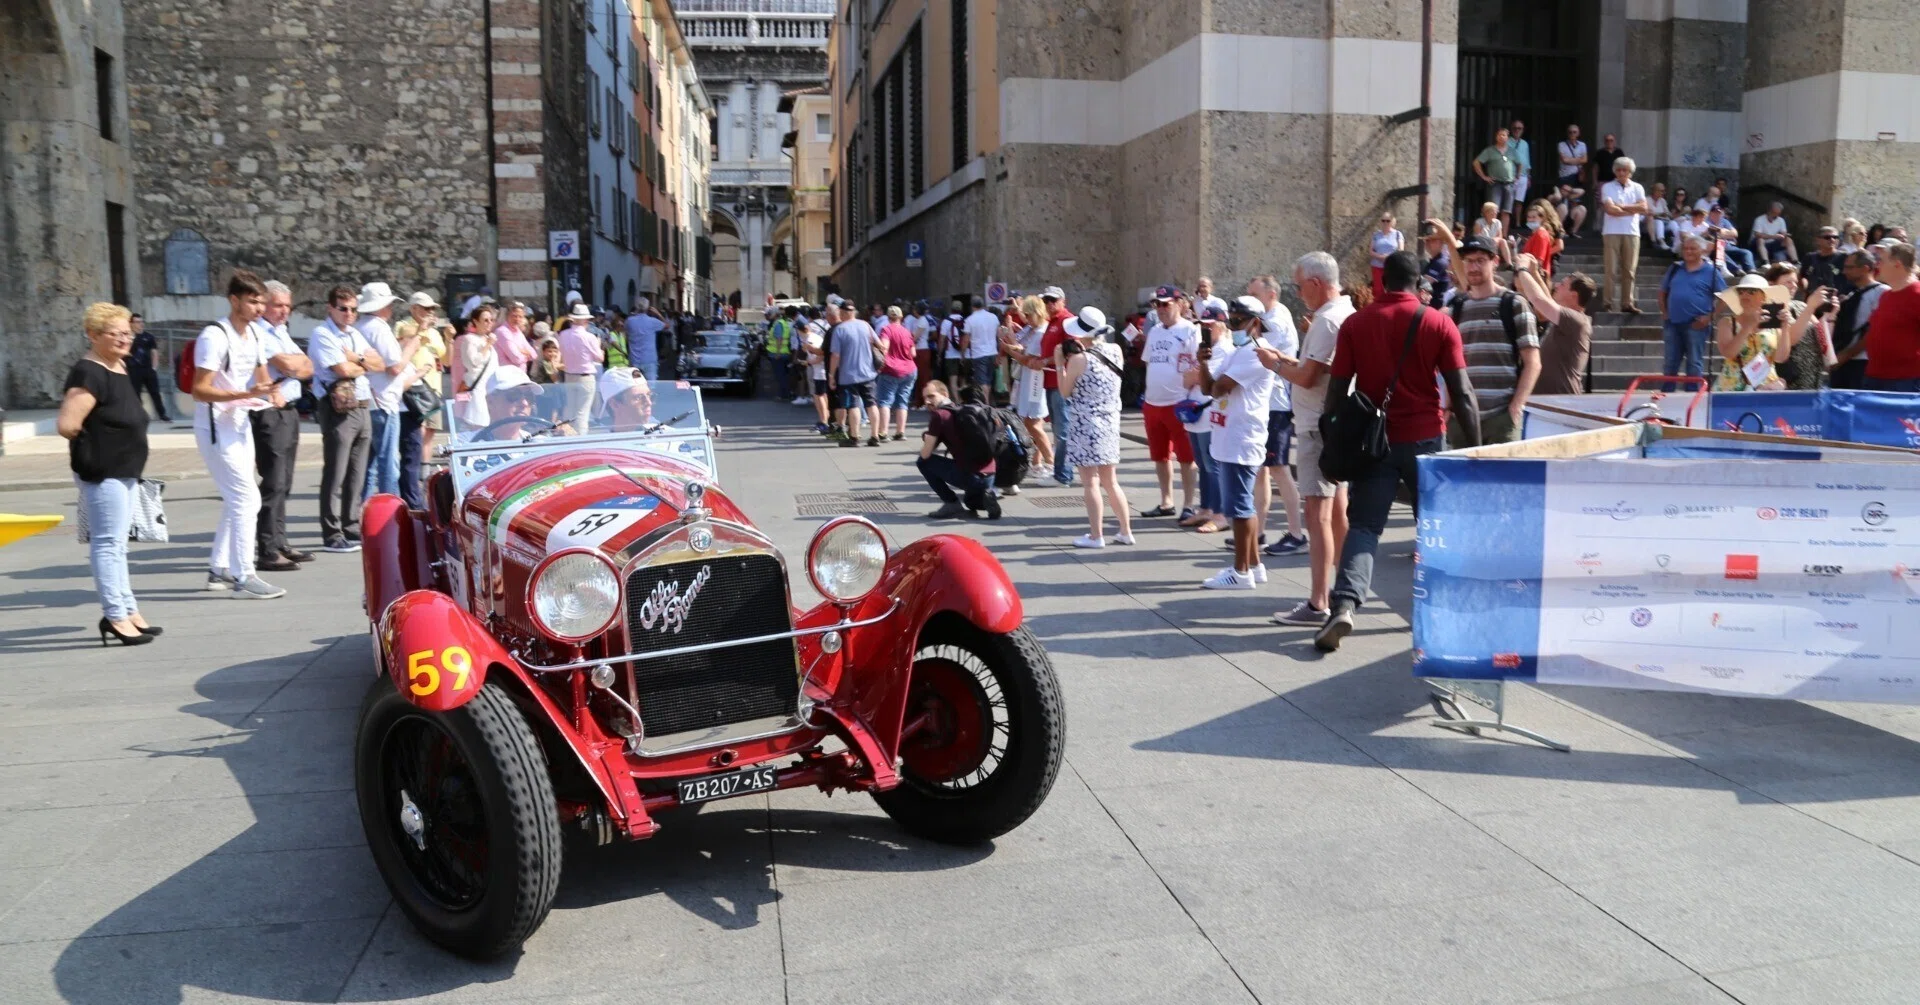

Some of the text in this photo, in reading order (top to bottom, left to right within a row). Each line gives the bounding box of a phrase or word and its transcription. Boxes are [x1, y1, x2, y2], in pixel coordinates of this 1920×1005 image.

[908, 242, 921, 257] P
[568, 513, 619, 537] 59
[640, 565, 711, 634] Alfa Romeo
[408, 646, 472, 696] 59
